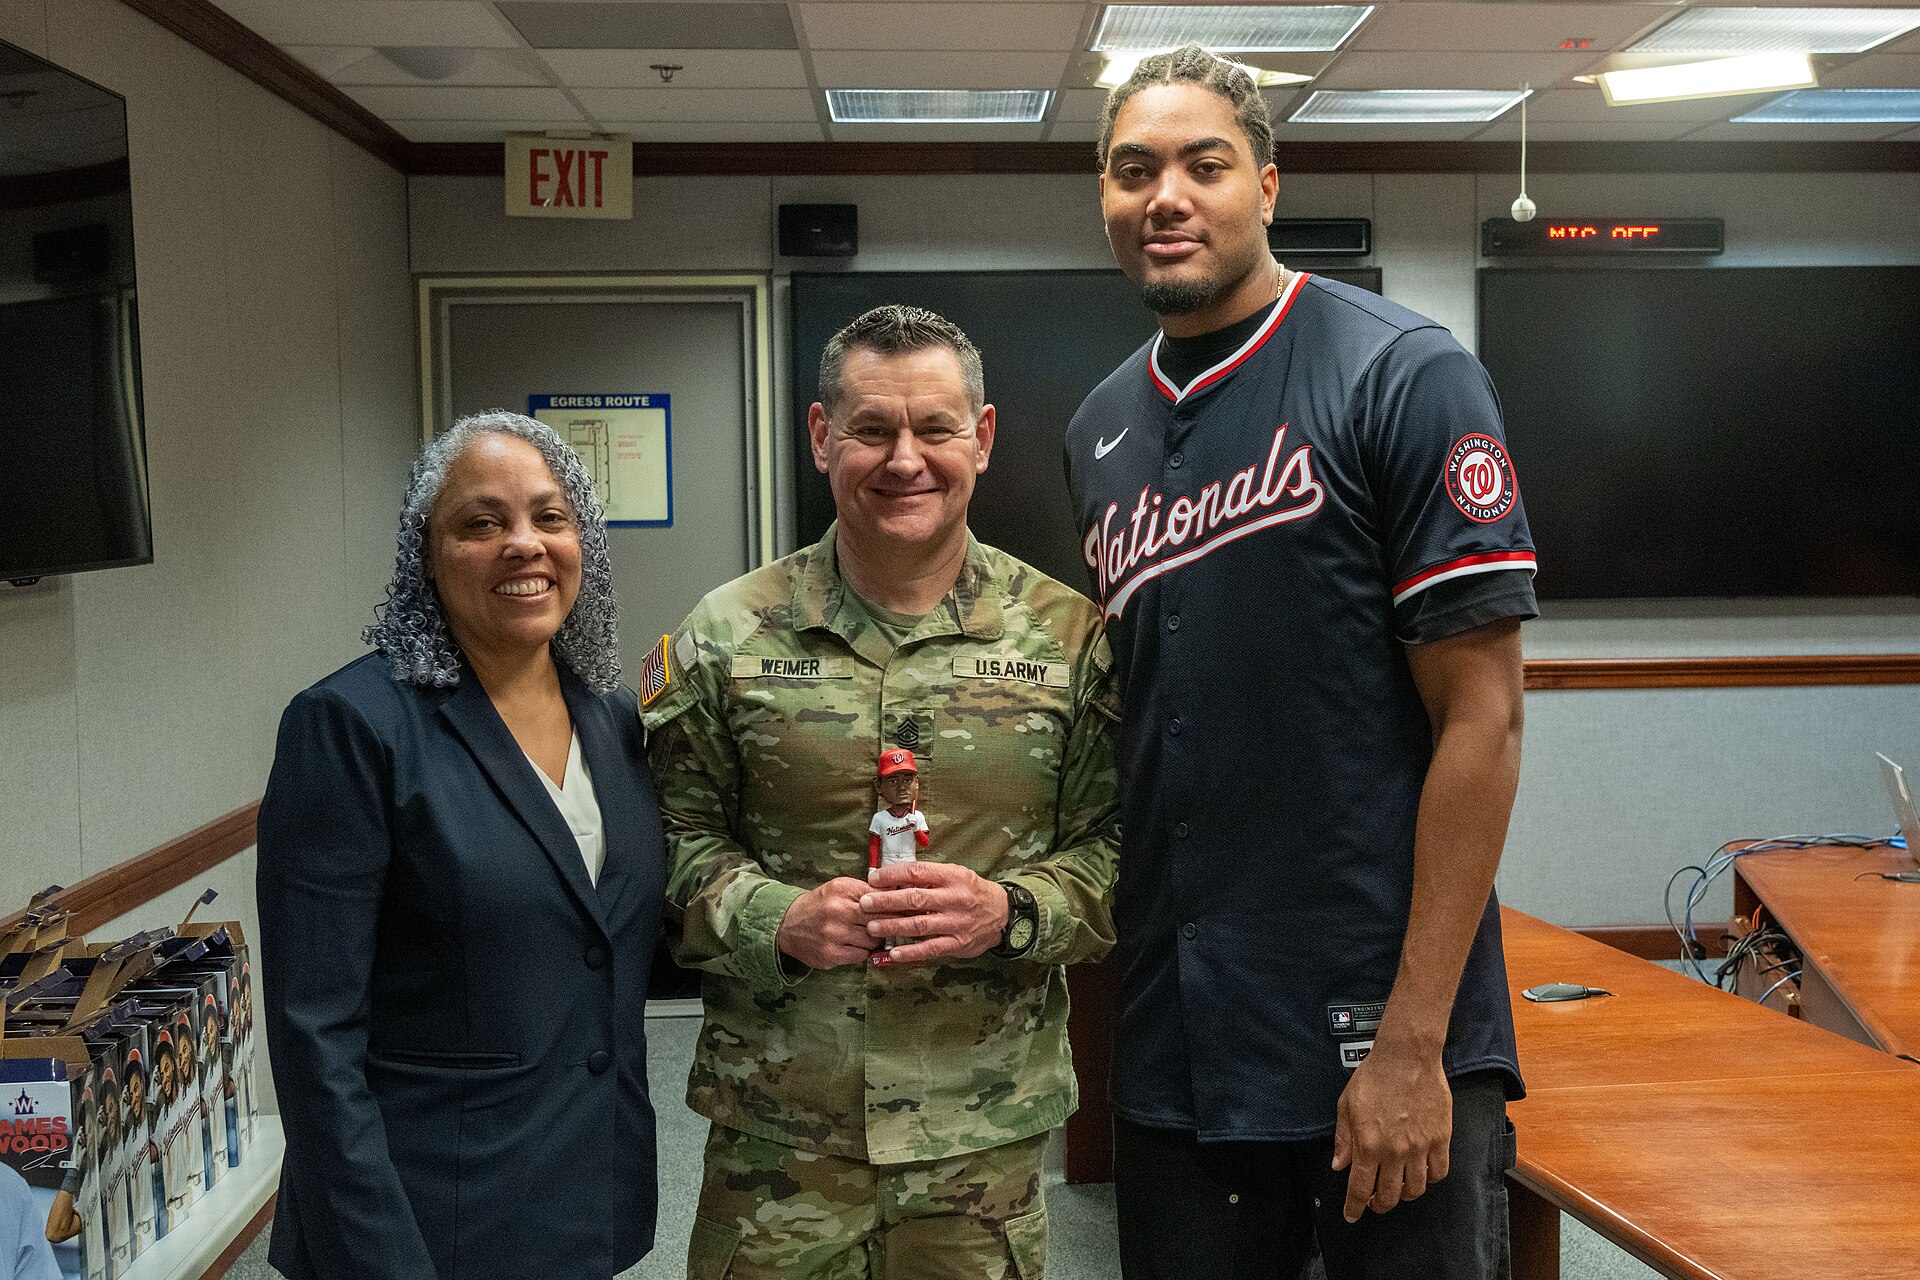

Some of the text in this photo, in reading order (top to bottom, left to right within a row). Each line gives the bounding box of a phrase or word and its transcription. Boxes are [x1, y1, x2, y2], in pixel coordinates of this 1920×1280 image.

[530, 149, 608, 208] EXIT
[550, 396, 650, 407] EGRESS ROUTE
[1449, 438, 1508, 472] WASHINGTON
[1456, 490, 1512, 518] NATIONALS
[1084, 422, 1326, 625] Nationals
[761, 658, 820, 676] WEIMER
[0, 1116, 68, 1136] AMES
